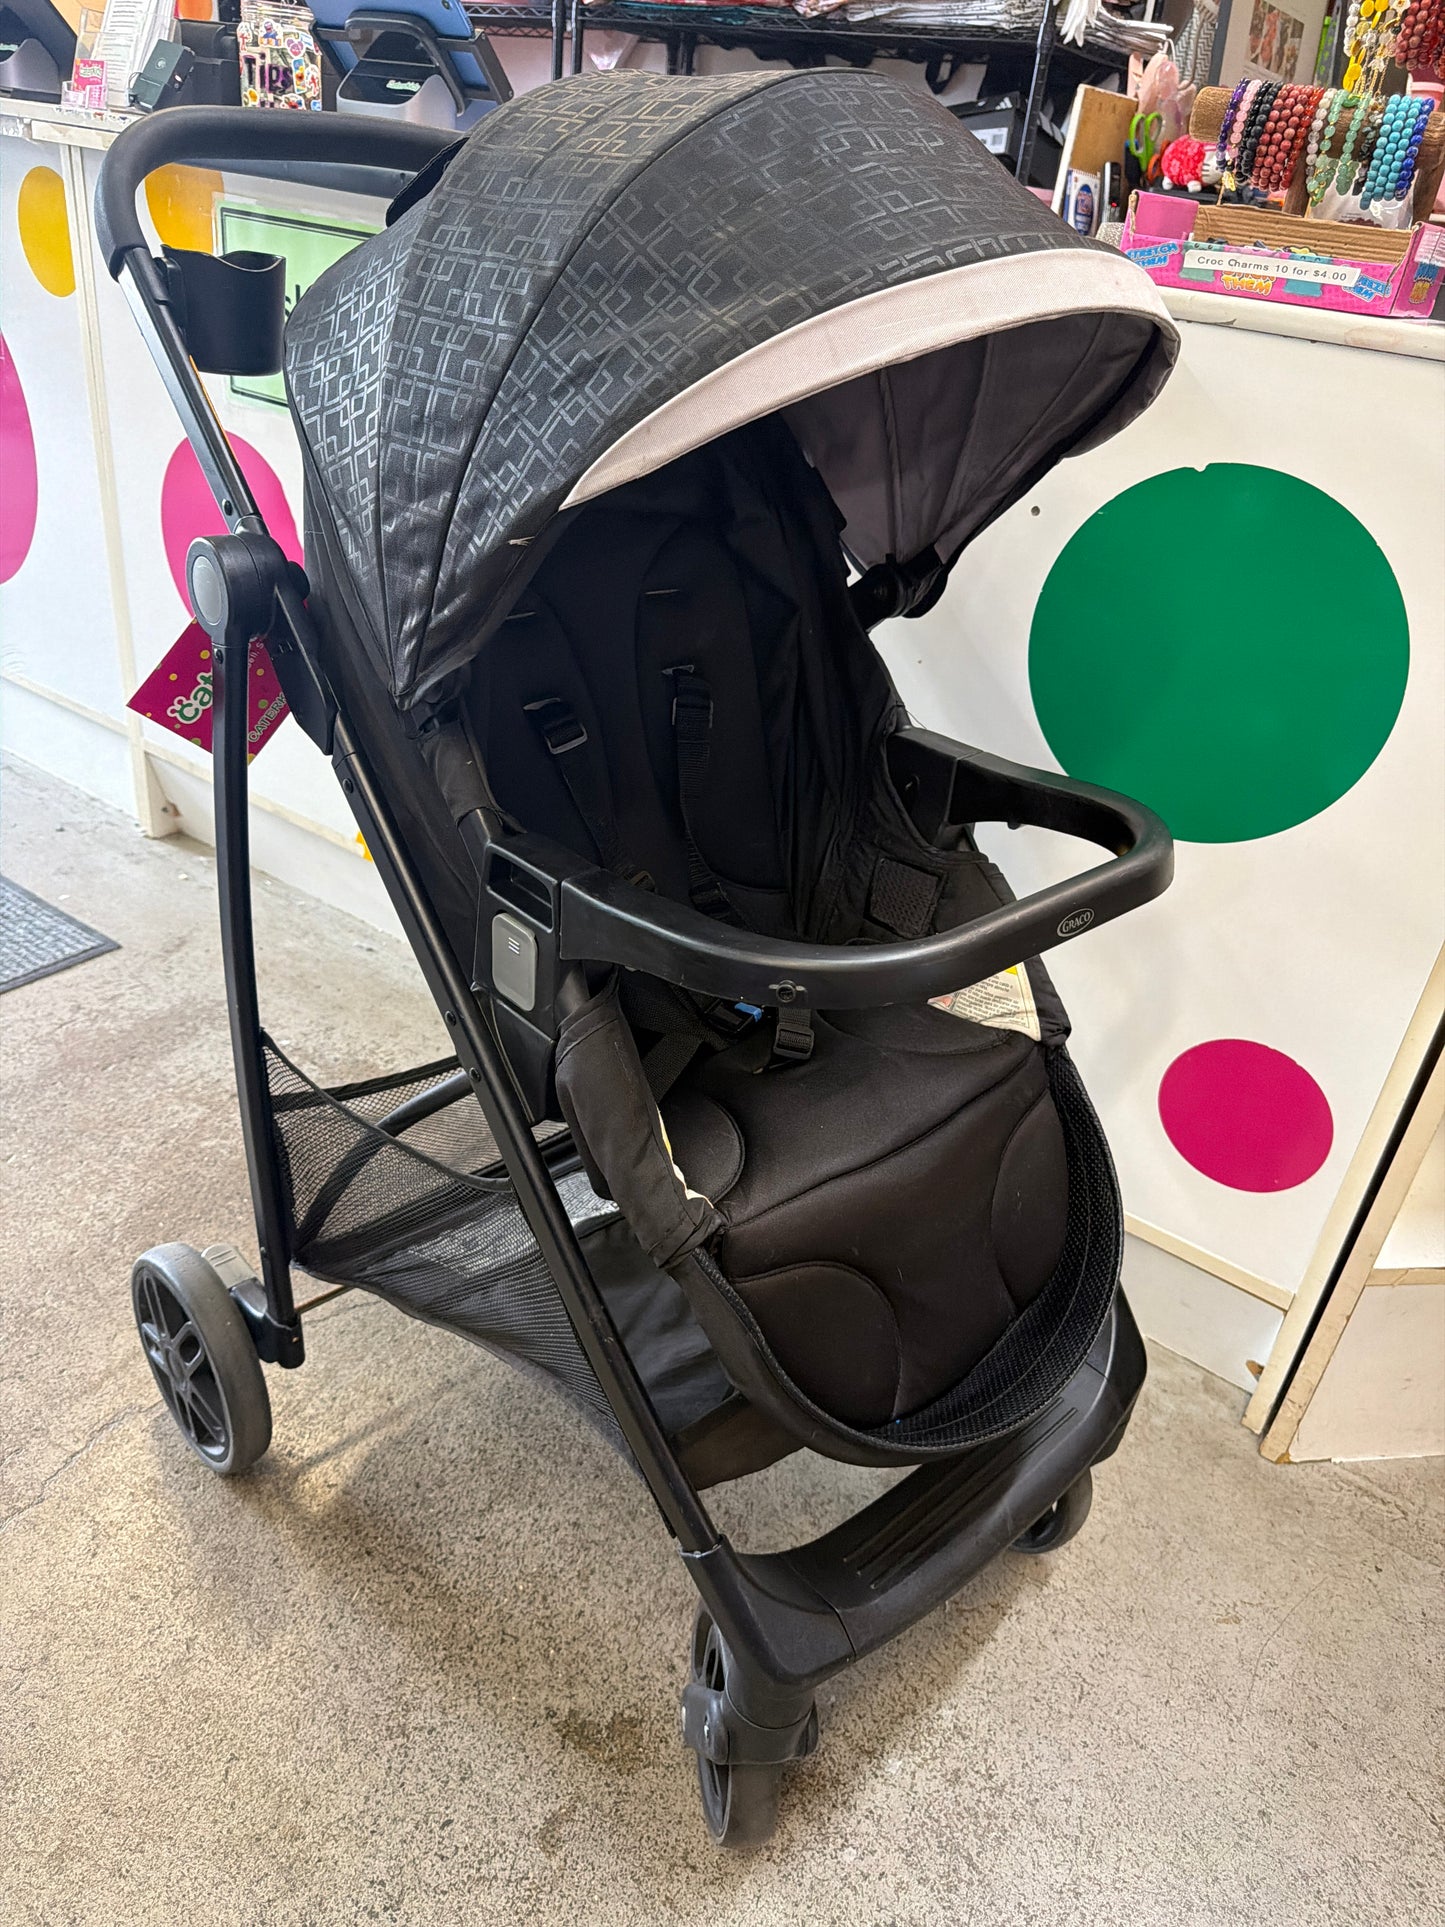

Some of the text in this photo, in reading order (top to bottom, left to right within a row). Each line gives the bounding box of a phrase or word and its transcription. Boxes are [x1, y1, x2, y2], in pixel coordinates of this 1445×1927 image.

[1197, 256, 1347, 282] Croc Charms 10 for $4.00
[1221, 275, 1273, 296] THEM
[1061, 911, 1092, 933] GRACO
